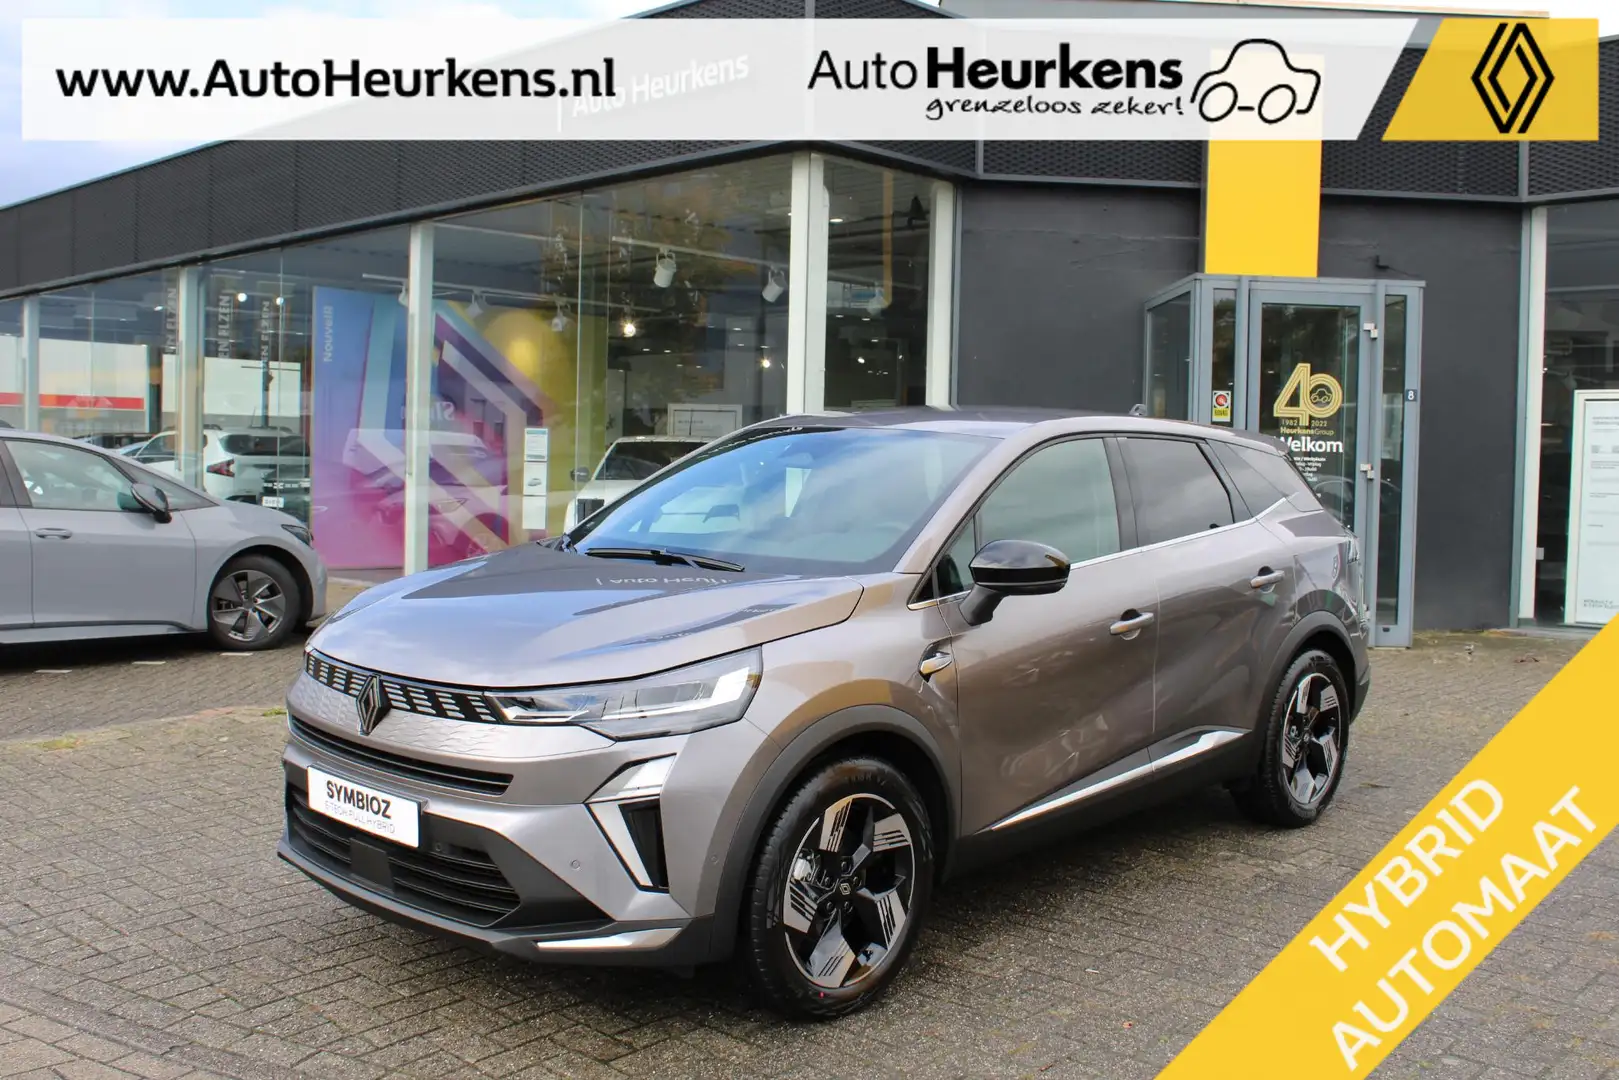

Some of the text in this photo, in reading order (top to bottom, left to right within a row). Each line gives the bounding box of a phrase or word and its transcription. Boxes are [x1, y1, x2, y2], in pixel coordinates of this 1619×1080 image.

[631, 54, 750, 105] Heurkens
[1407, 390, 1415, 401] 8
[1281, 418, 1328, 428] 1982 2022
[326, 779, 392, 820] SYMBIOZ
